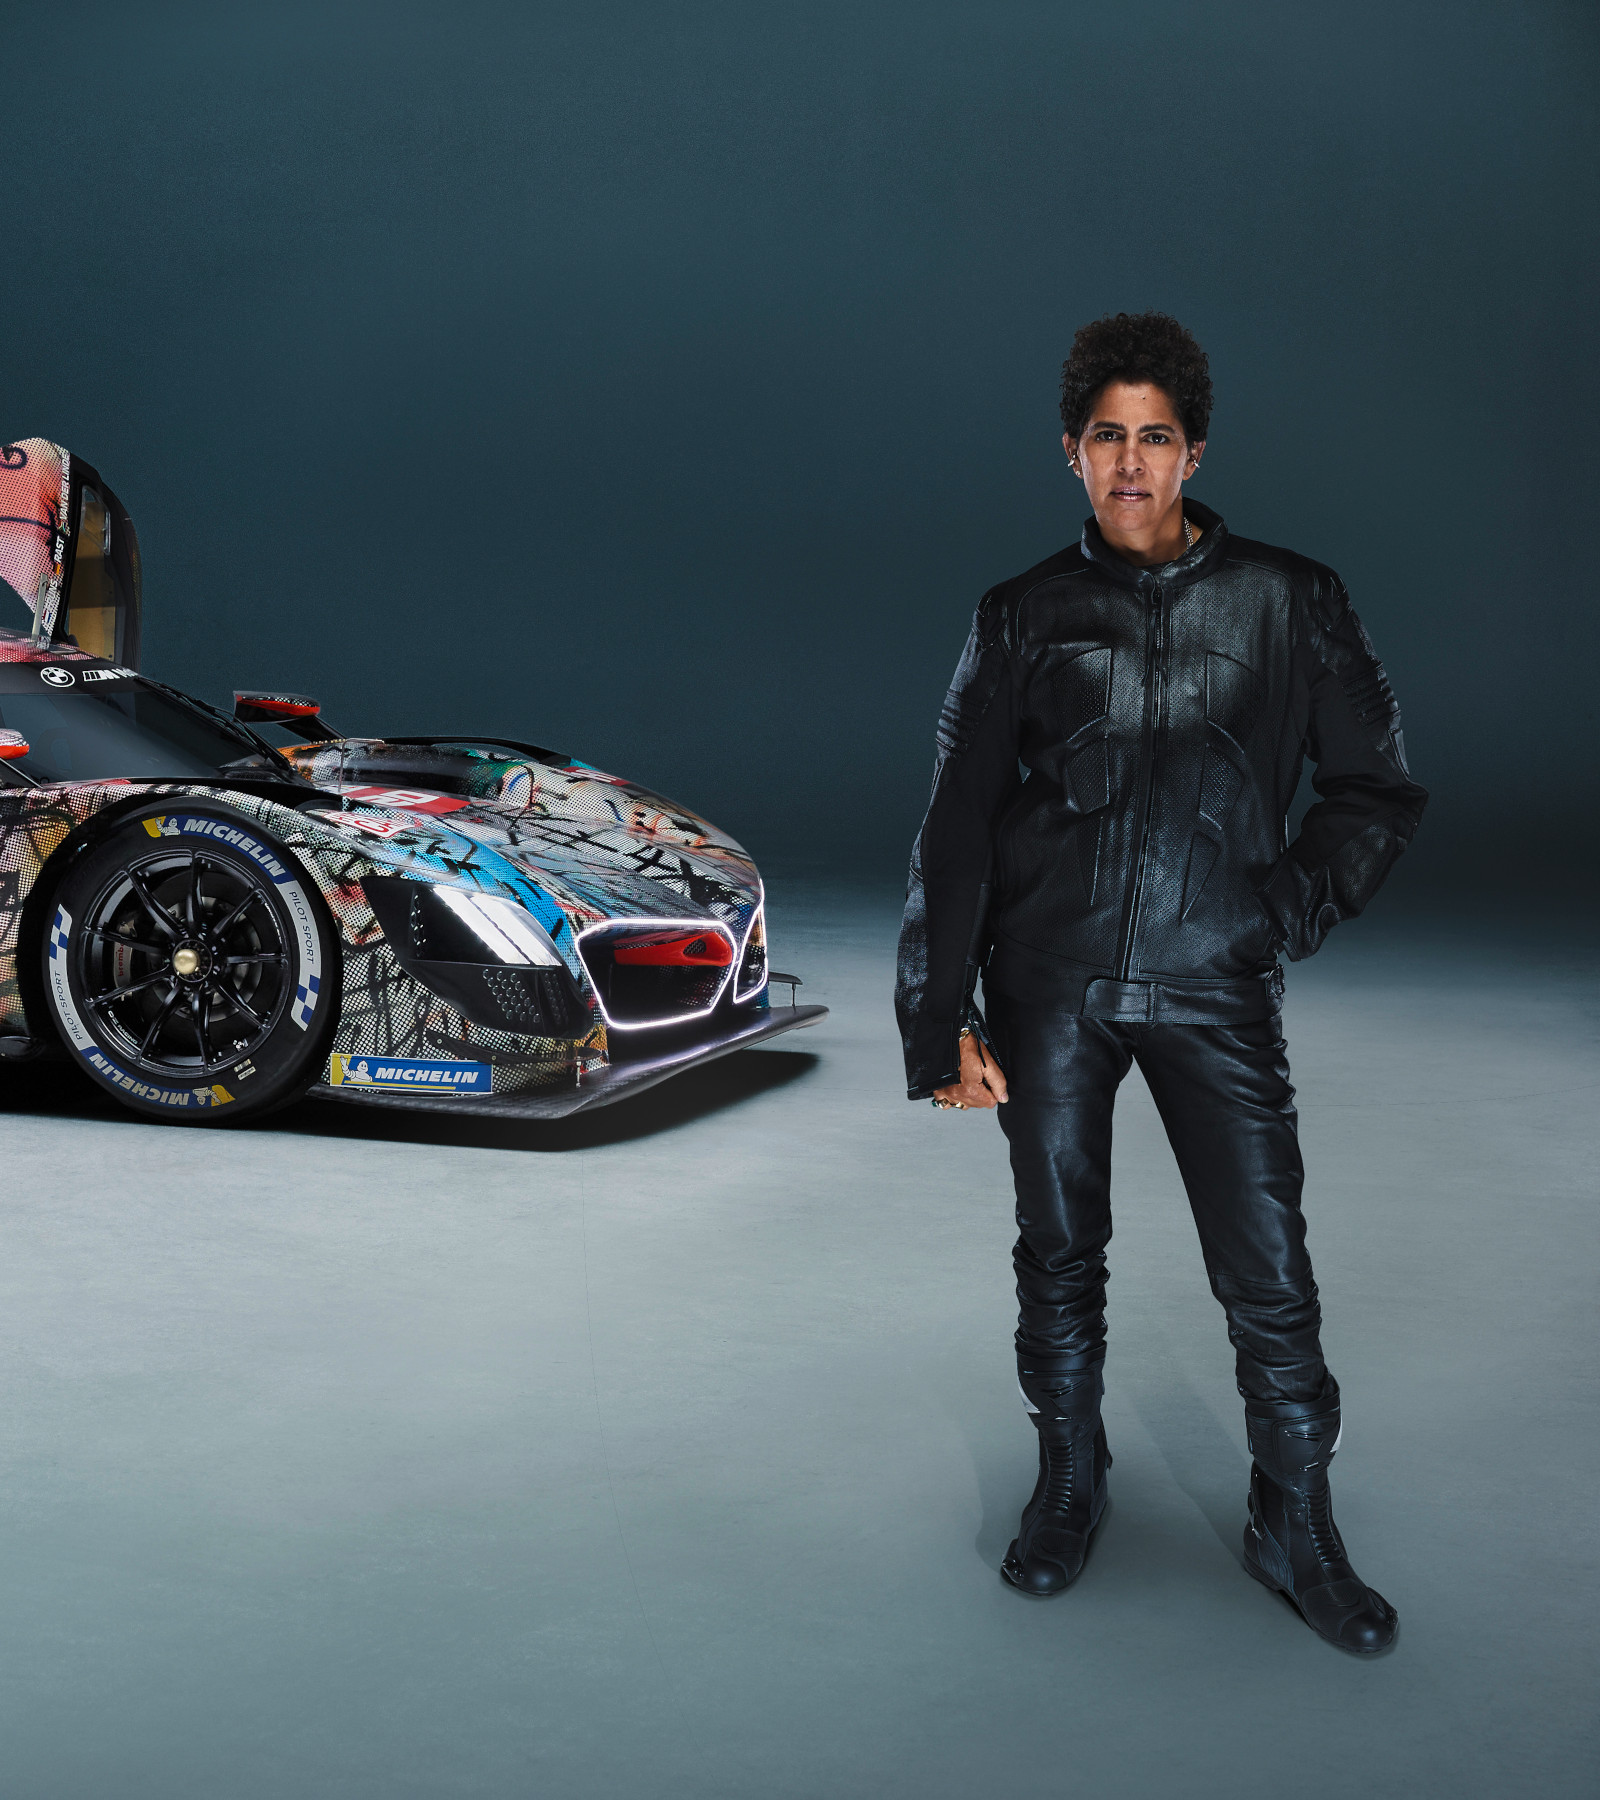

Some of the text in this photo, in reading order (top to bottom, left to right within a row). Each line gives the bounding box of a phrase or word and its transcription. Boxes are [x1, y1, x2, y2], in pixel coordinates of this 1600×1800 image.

[60, 501, 68, 520] VAN
[61, 481, 69, 500] DER
[54, 536, 64, 563] RAST
[183, 818, 287, 877] MICHELIN
[289, 891, 314, 964] PILOT SPORT
[54, 972, 83, 1041] PILOT SPORT
[89, 1053, 190, 1106] MICHELIN
[375, 1067, 479, 1084] MICHELIN
